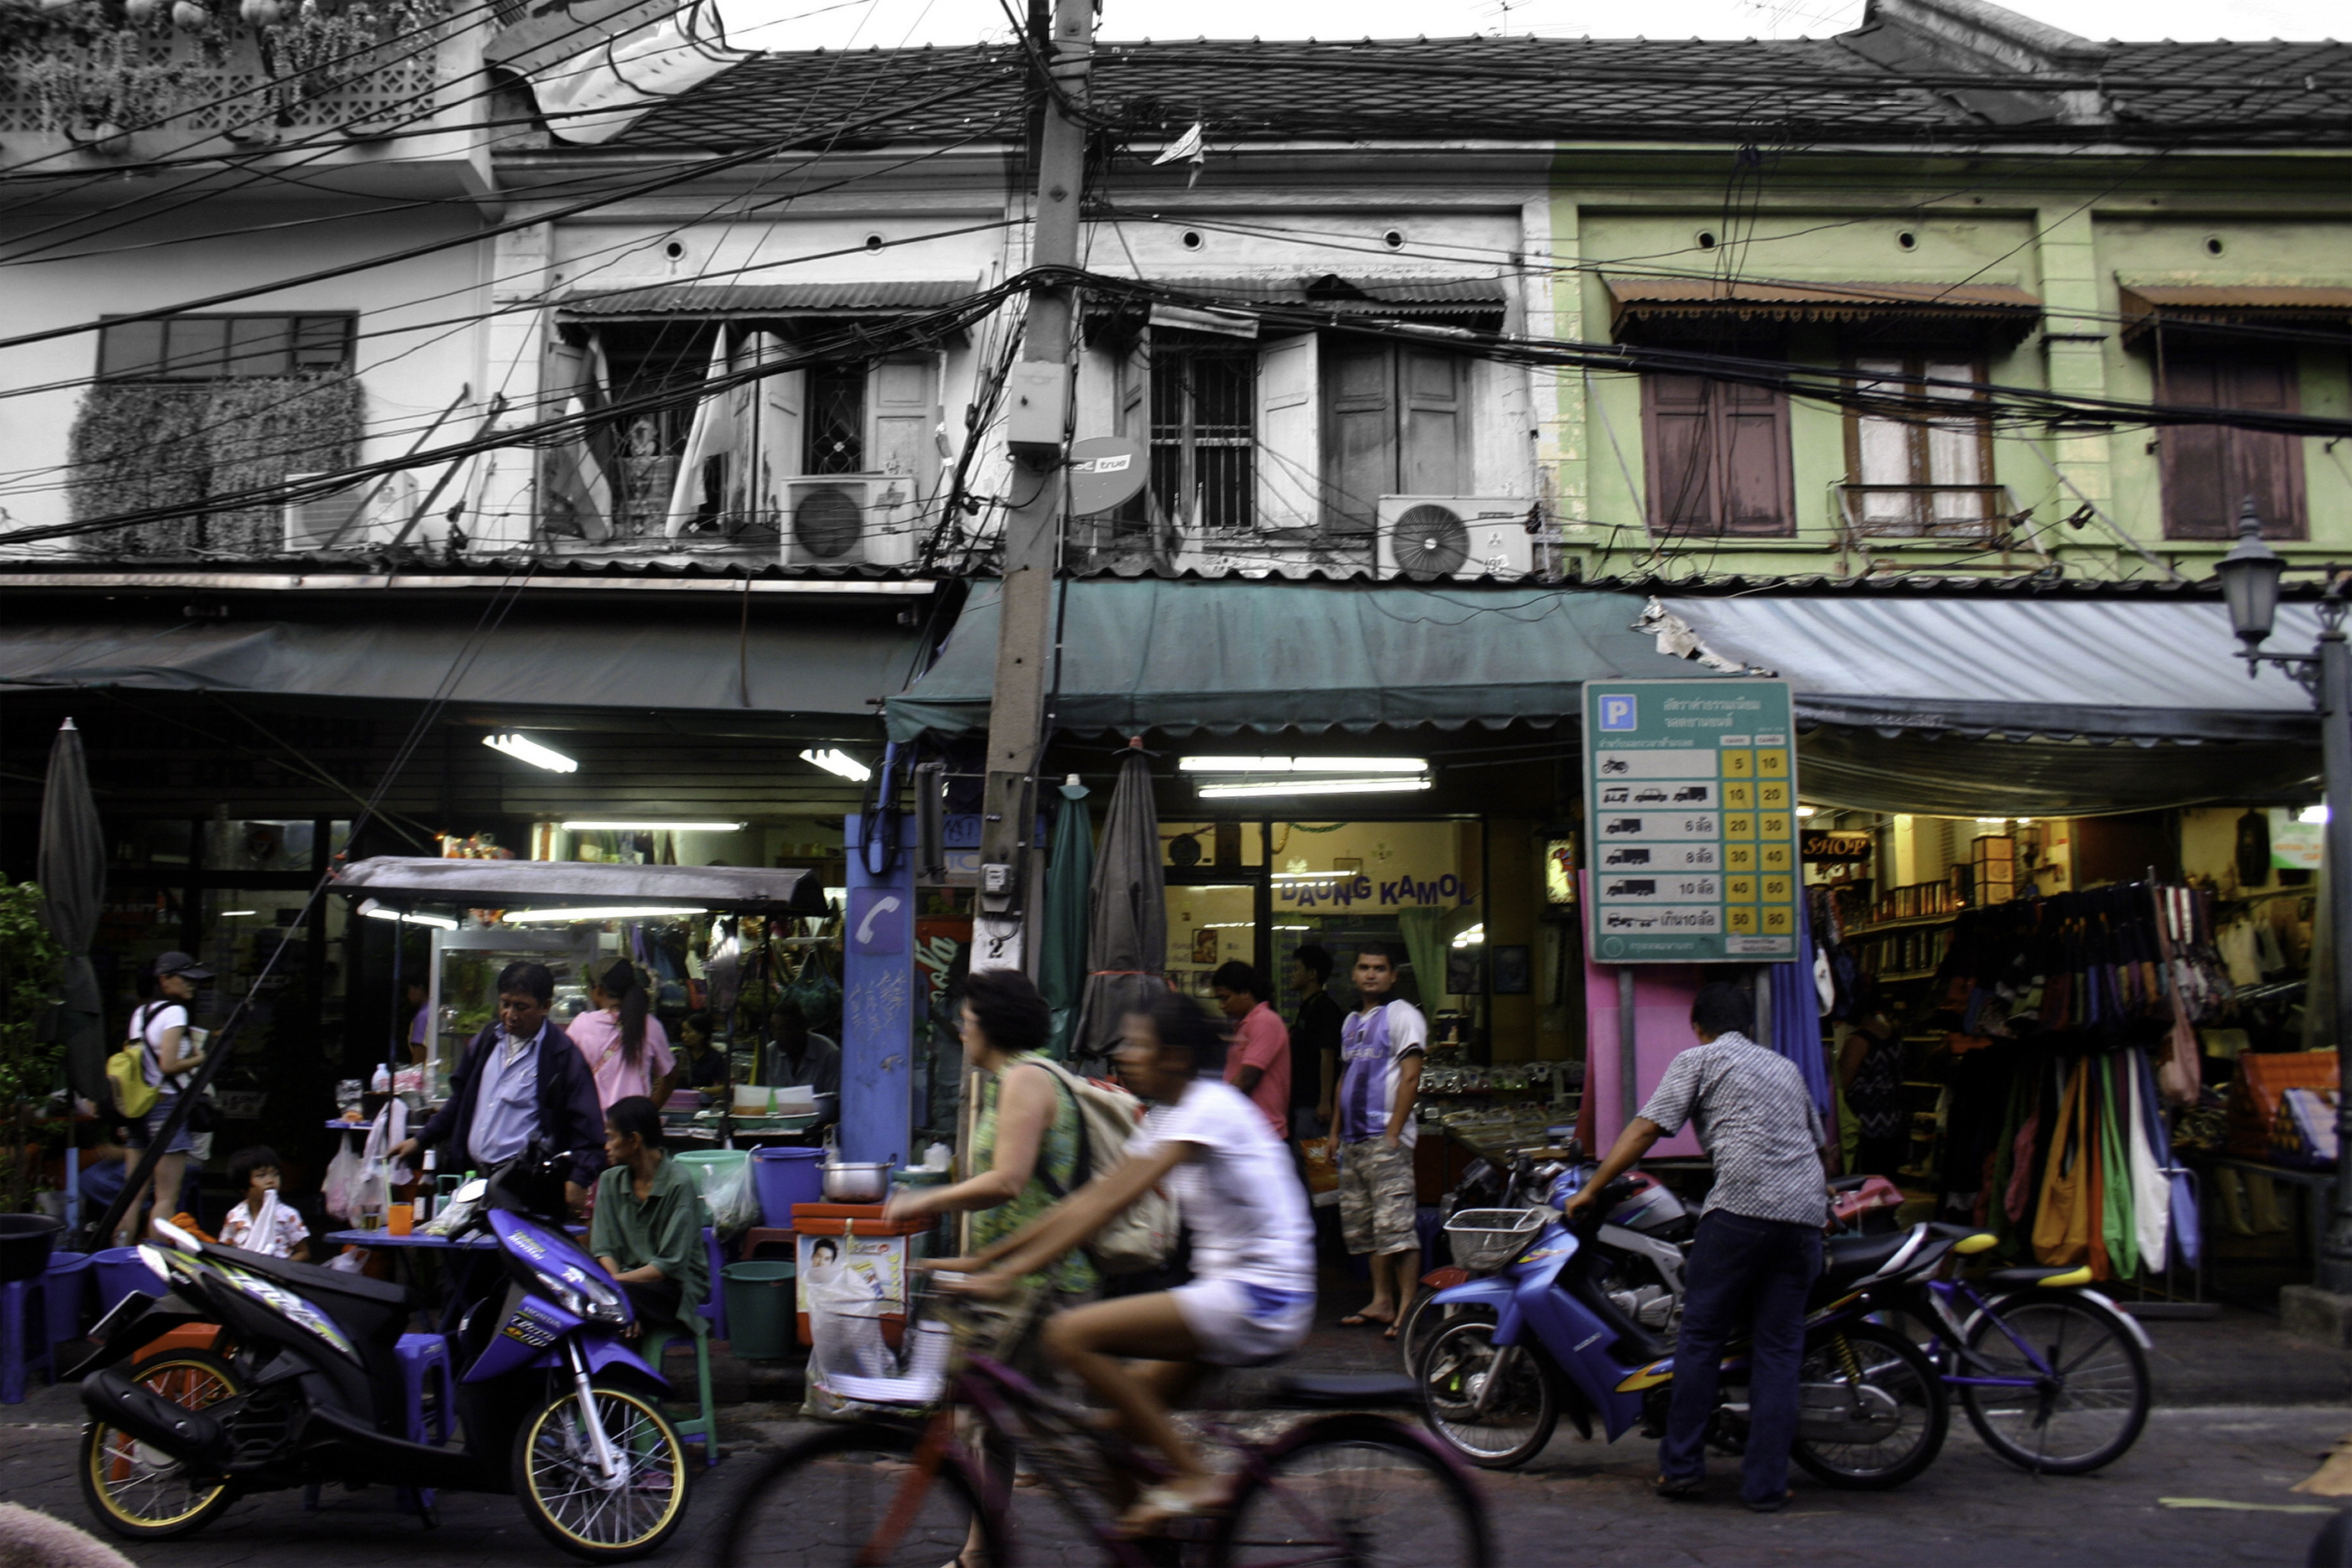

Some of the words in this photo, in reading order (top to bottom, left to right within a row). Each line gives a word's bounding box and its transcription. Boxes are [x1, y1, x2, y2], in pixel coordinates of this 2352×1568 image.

[1100, 459, 1127, 469] true
[1607, 701, 1629, 725] P
[1734, 758, 1743, 769] 5
[1762, 758, 1778, 769] 10
[1729, 789, 1744, 801] 10
[1764, 789, 1780, 801] 20
[1730, 820, 1747, 832] 20
[1765, 820, 1782, 832] 30
[1803, 836, 1867, 855] SHOP
[1731, 851, 1748, 862] 30
[1766, 851, 1783, 862] 40
[1281, 877, 1371, 907] DAUNG
[1380, 873, 1475, 906] KAMOL
[1731, 882, 1748, 894] 40
[1767, 882, 1784, 893] 60
[1733, 913, 1749, 925] 50
[1768, 913, 1785, 925] 80
[989, 937, 1003, 958] 2
